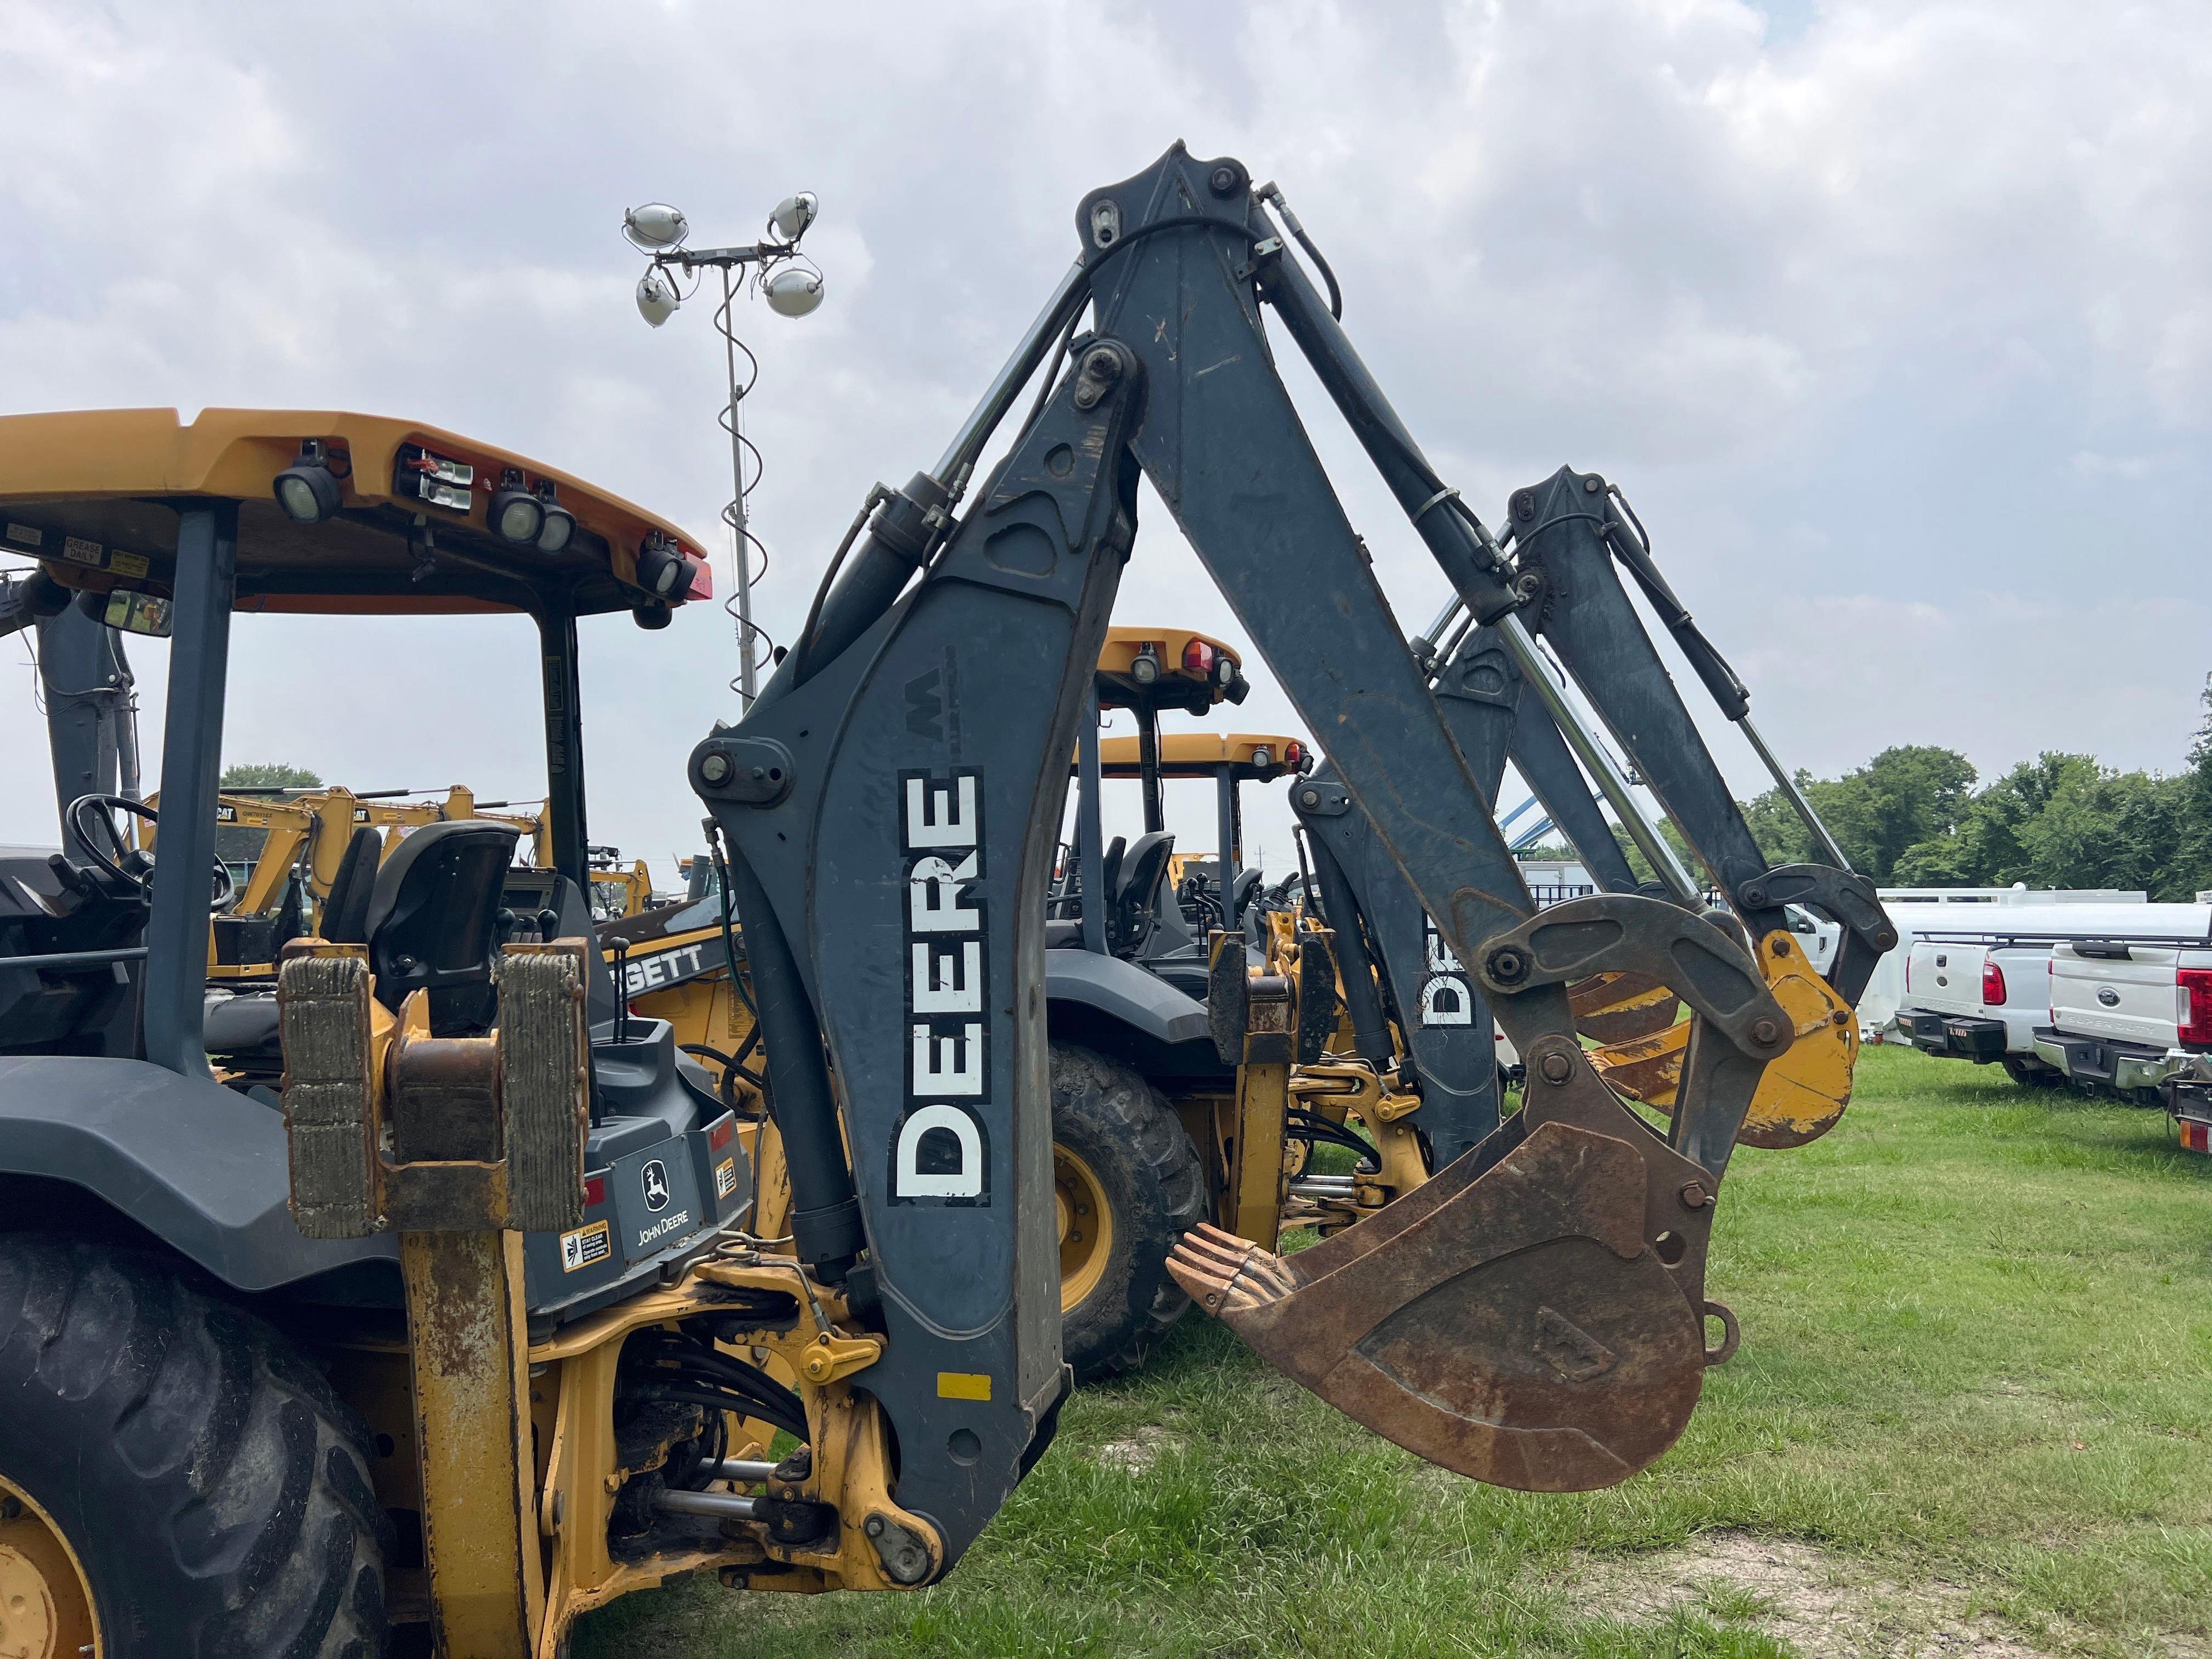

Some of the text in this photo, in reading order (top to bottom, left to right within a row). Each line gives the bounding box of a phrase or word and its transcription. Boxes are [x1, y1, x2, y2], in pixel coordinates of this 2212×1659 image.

[66, 538, 101, 554] GREASE
[70, 548, 95, 562] DAILY
[217, 807, 233, 820] CAT
[609, 944, 702, 995] GETT
[1422, 914, 1472, 1024] DE
[897, 776, 982, 1196] DEERE
[2068, 1016, 2156, 1035] SUPER DUTY
[586, 1222, 607, 1234] WARNING
[638, 1210, 688, 1247] JOHN DEERE
[591, 1233, 603, 1241] CLEAR
